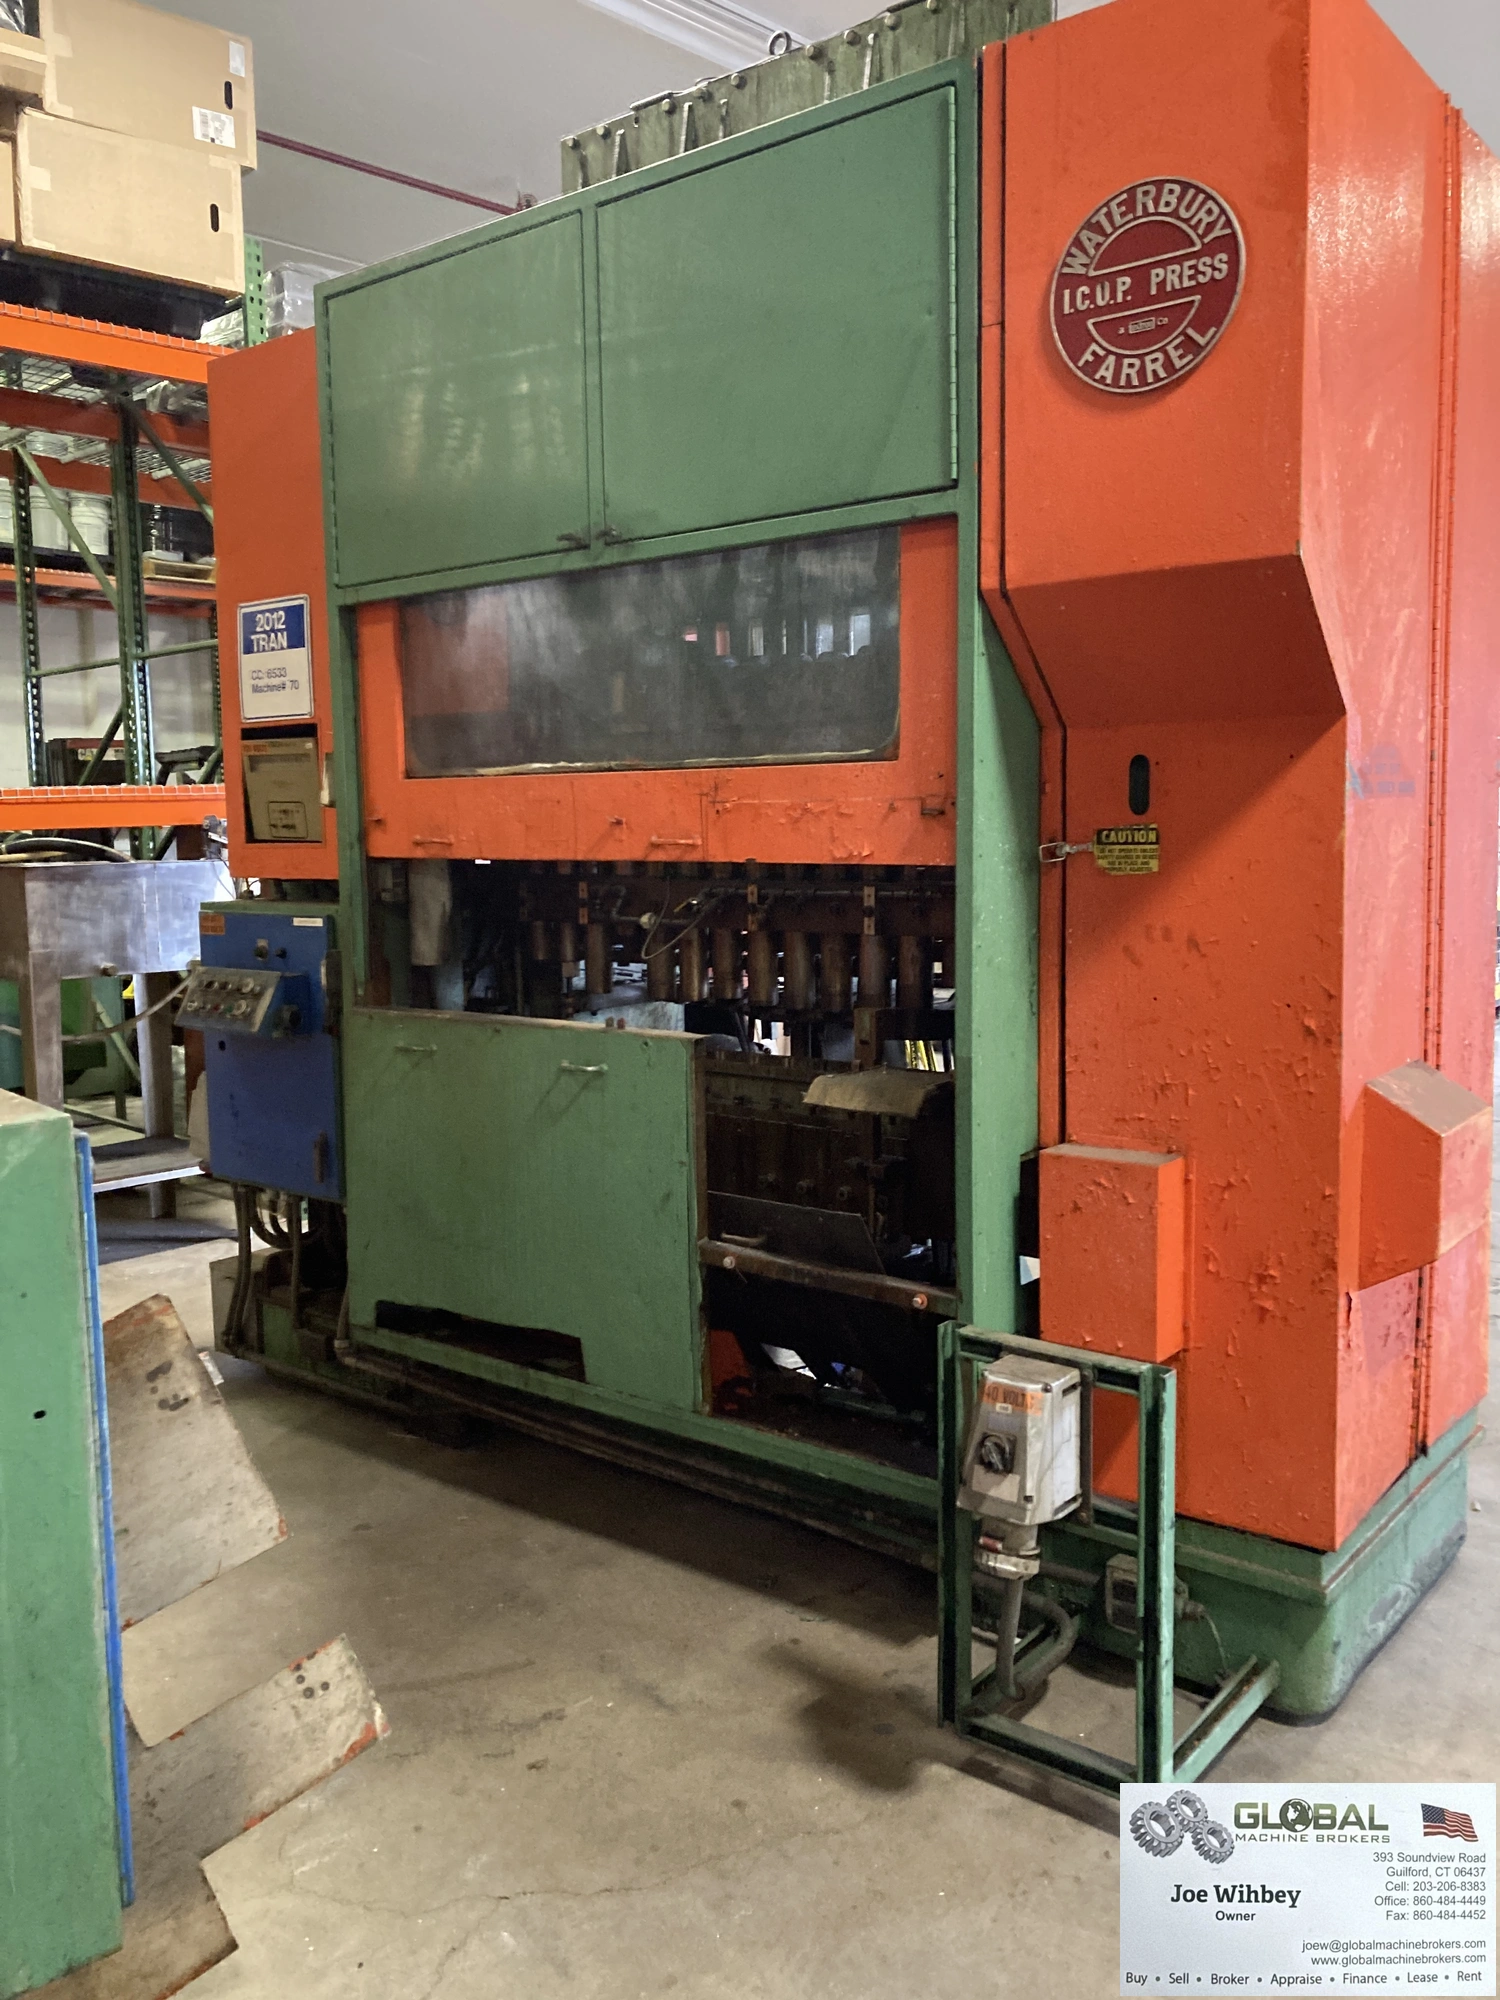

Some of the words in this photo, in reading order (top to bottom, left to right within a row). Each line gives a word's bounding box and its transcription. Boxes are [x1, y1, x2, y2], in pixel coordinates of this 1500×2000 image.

[1062, 183, 1232, 275] WATERBURY
[1063, 276, 1132, 315] I.C.U.P.
[1150, 252, 1229, 295] PRESS
[1077, 326, 1217, 387] FARREL
[255, 610, 286, 632] 2012
[250, 631, 288, 653] TRAN
[251, 681, 287, 694] Machine#
[289, 680, 300, 690] 70
[1101, 829, 1157, 843] CAUTION
